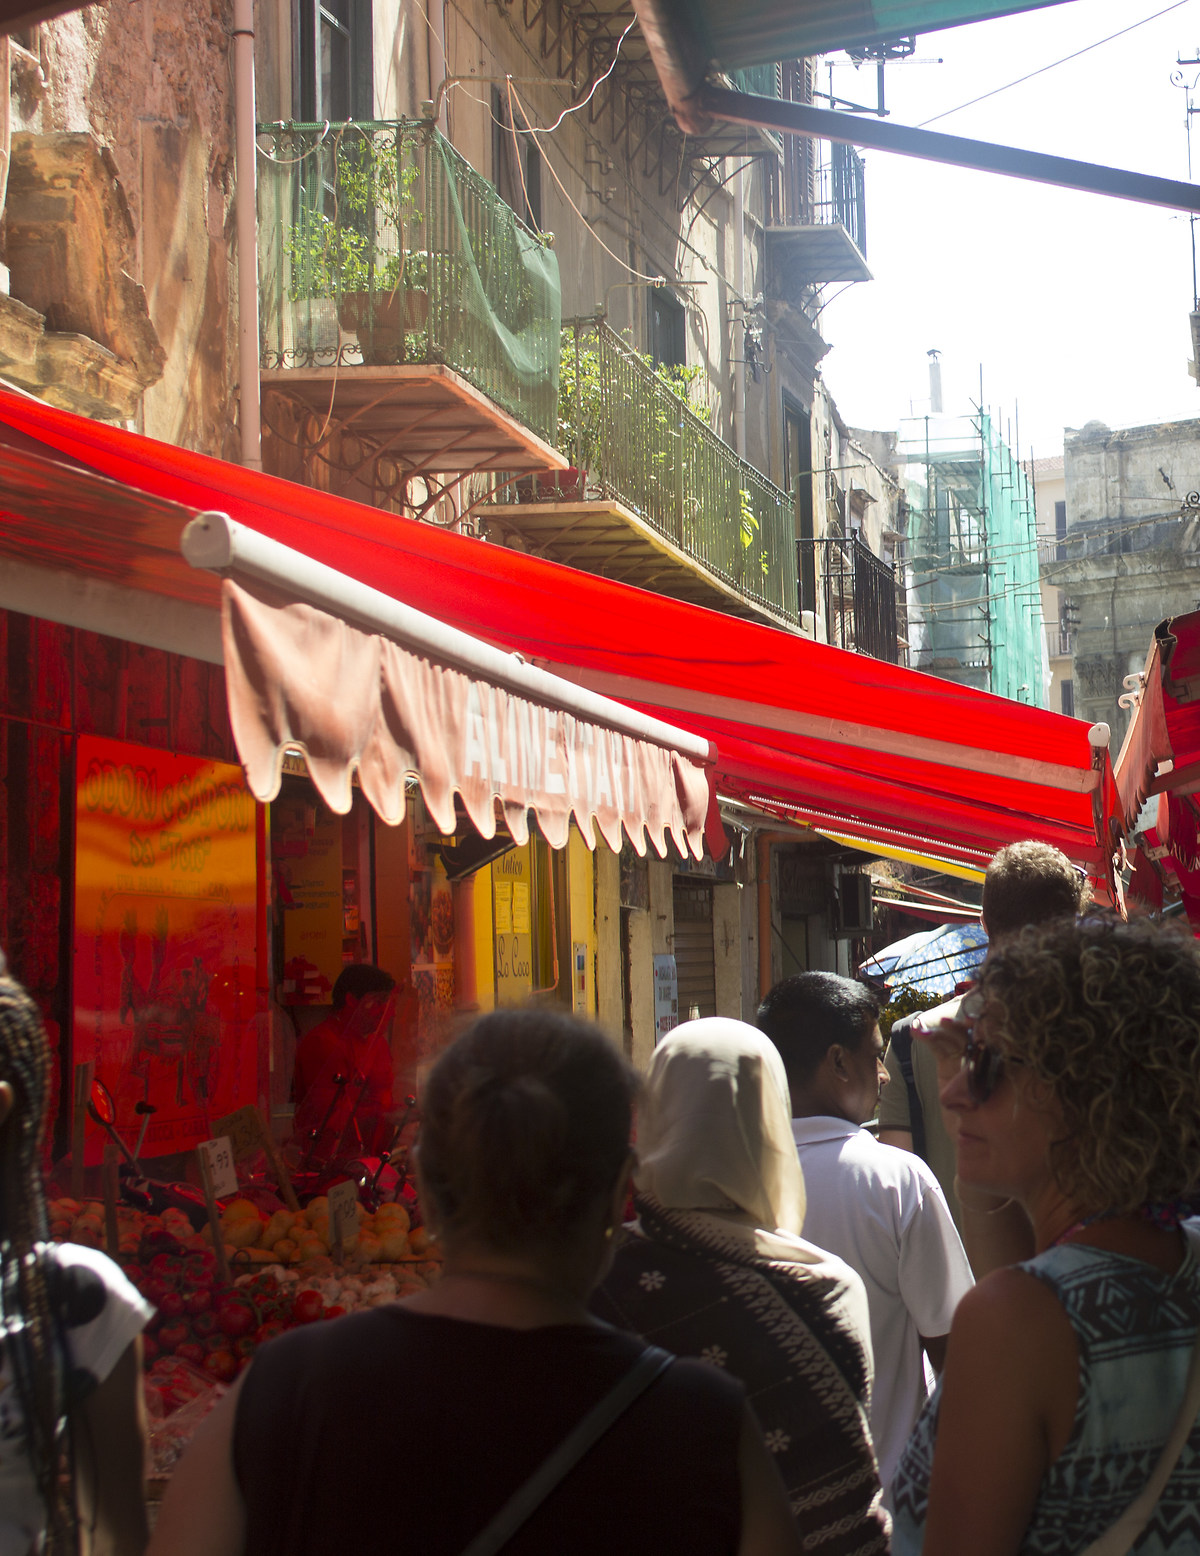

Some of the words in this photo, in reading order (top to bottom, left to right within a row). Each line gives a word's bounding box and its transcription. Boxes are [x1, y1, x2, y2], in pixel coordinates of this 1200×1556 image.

[464, 680, 636, 814] ALIMENTARI
[85, 757, 157, 820] ODORI
[497, 853, 523, 876] Antico
[497, 936, 509, 978] Lo
[511, 936, 530, 978] Coco
